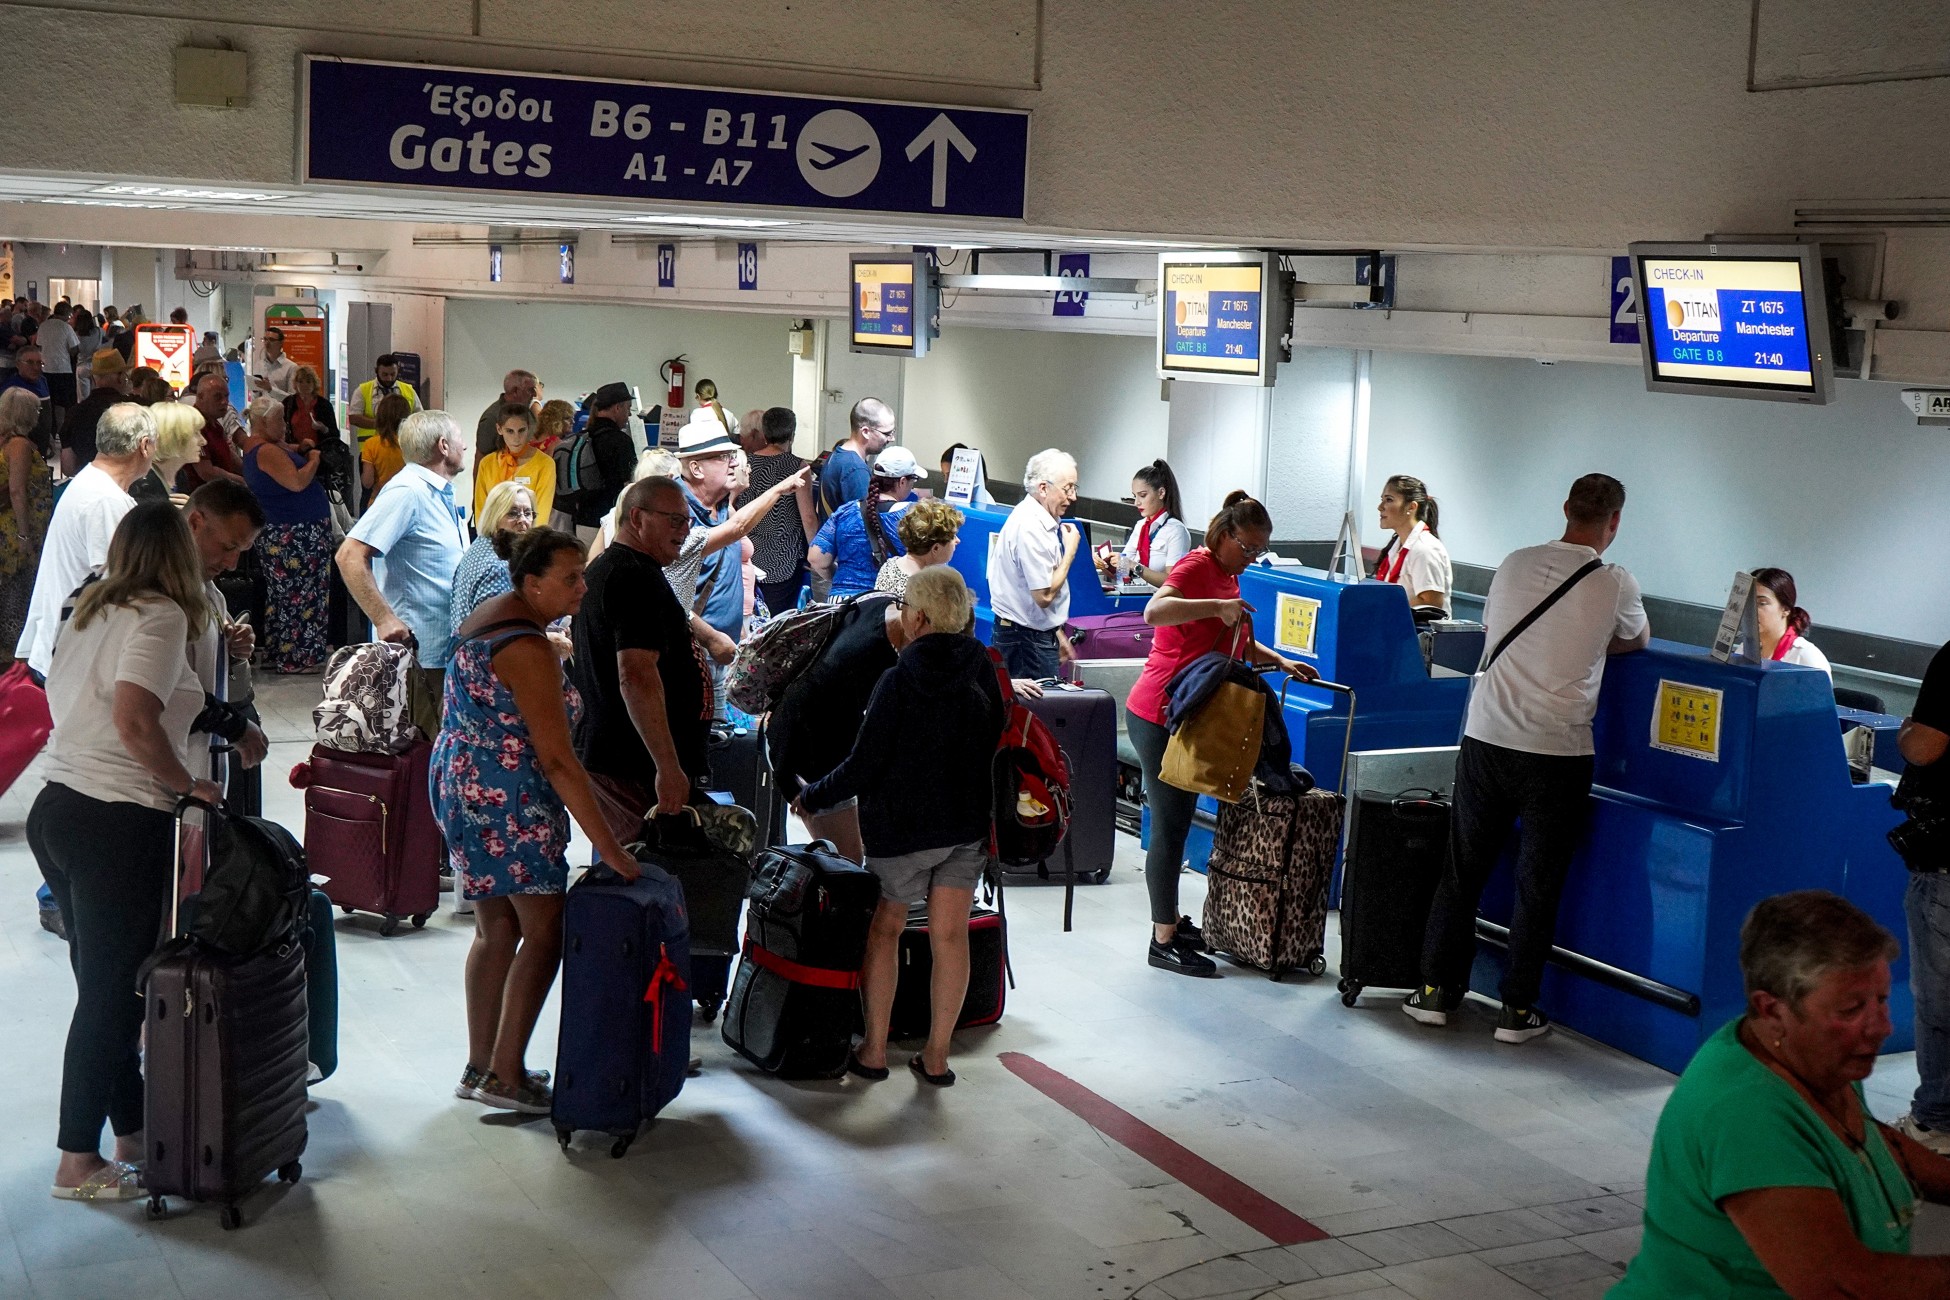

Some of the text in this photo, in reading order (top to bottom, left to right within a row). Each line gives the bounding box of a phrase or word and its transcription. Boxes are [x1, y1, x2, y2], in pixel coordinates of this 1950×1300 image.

[422, 82, 554, 125] Έξοδοι
[590, 100, 651, 141] B6
[703, 107, 789, 151] B11
[388, 123, 553, 178] Gates
[622, 152, 667, 182] A1
[705, 157, 754, 187] A7
[658, 249, 674, 280] 17
[739, 250, 756, 283] 18
[1172, 273, 1203, 284] CHECK-IN
[1653, 268, 1704, 280] CHECK-IN
[1187, 301, 1208, 316] TITAN
[1222, 300, 1248, 311] ZT 1675
[1683, 301, 1719, 319] TITAN
[1741, 300, 1784, 314] ZT 1675
[1217, 318, 1253, 330] Manchester
[1736, 321, 1795, 336] Manchester
[1177, 326, 1206, 338] Departure
[1672, 329, 1720, 344] Departure
[1176, 341, 1194, 352] GATE
[1225, 343, 1243, 355] 21:40
[1673, 347, 1724, 362] GATE B 8
[1754, 352, 1783, 365] 21:40
